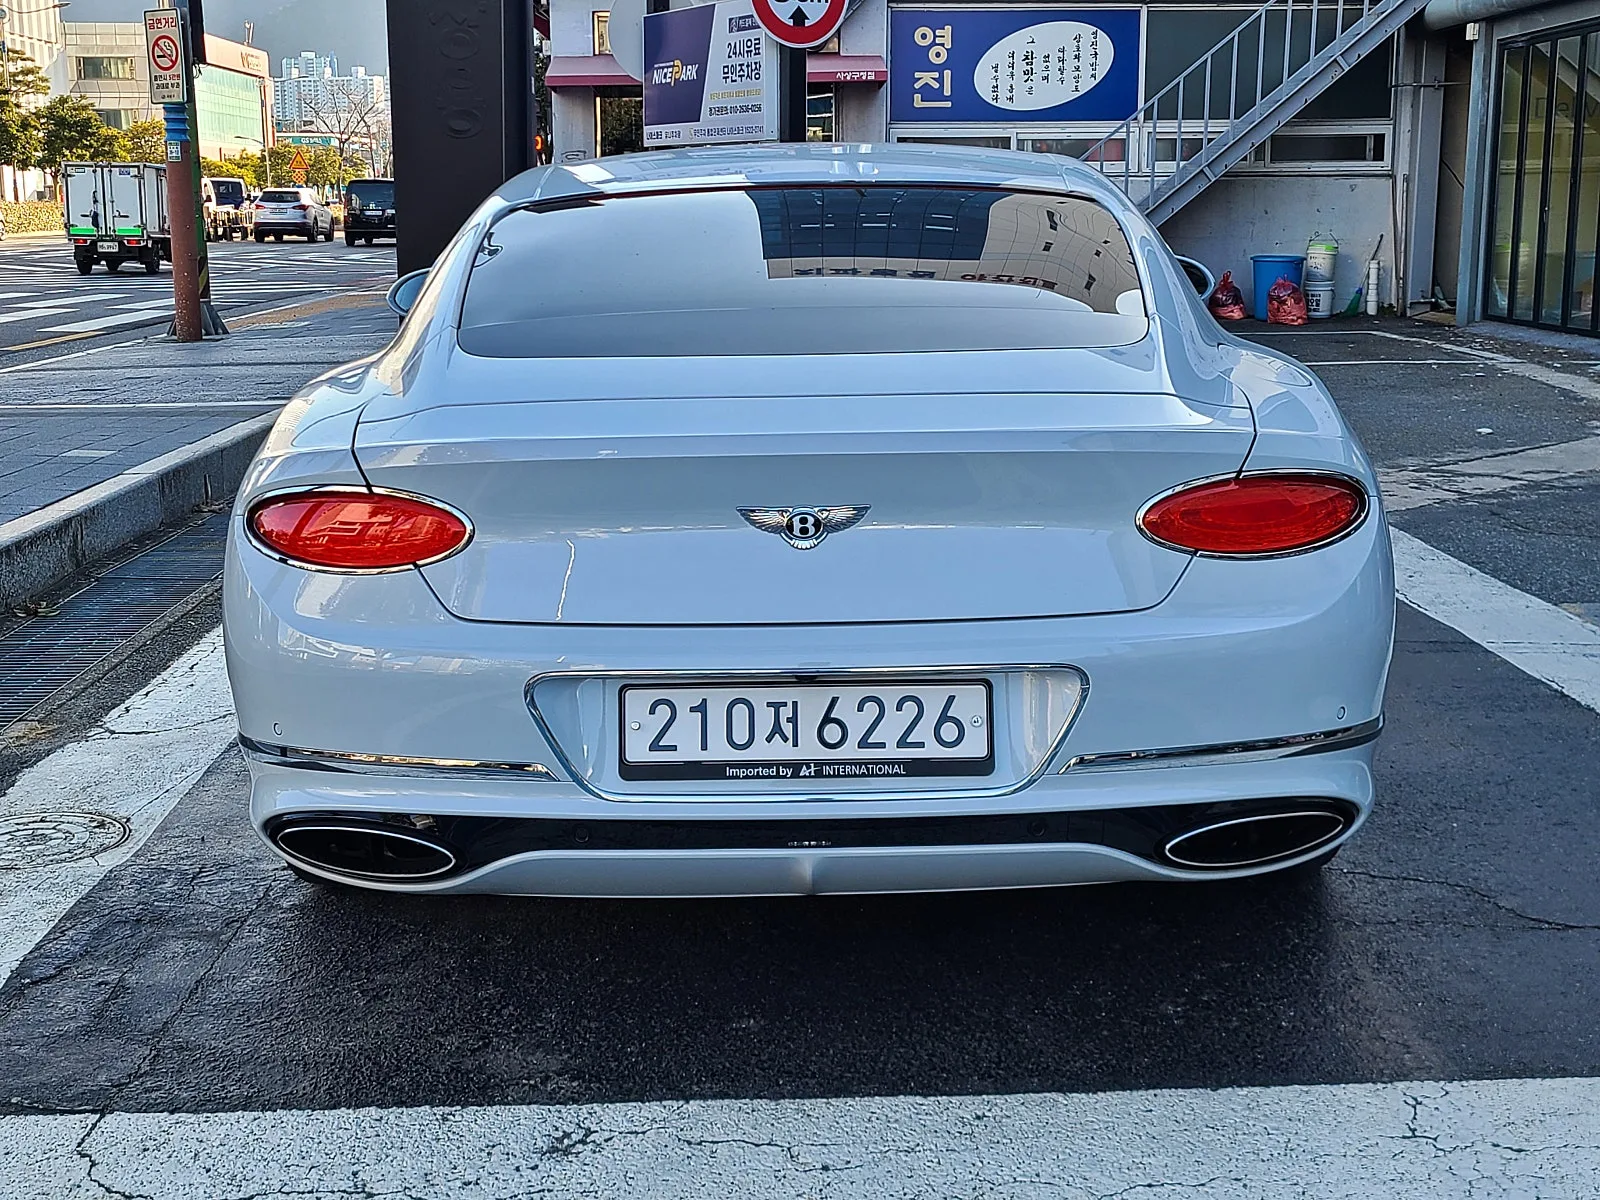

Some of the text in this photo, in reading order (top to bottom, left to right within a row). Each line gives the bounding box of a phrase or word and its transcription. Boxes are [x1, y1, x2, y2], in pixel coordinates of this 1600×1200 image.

[148, 17, 177, 30] 금연거리
[727, 37, 762, 59] 24시유료
[1026, 35, 1036, 45] 그
[722, 61, 762, 85] 무인주차장
[913, 24, 953, 109] 영진
[1041, 53, 1051, 84] 없으며
[792, 514, 816, 538] B
[816, 694, 967, 750] 6226
[725, 765, 777, 779] Imported
[778, 765, 793, 779] by
[822, 763, 907, 777] INTERNATIONAL
